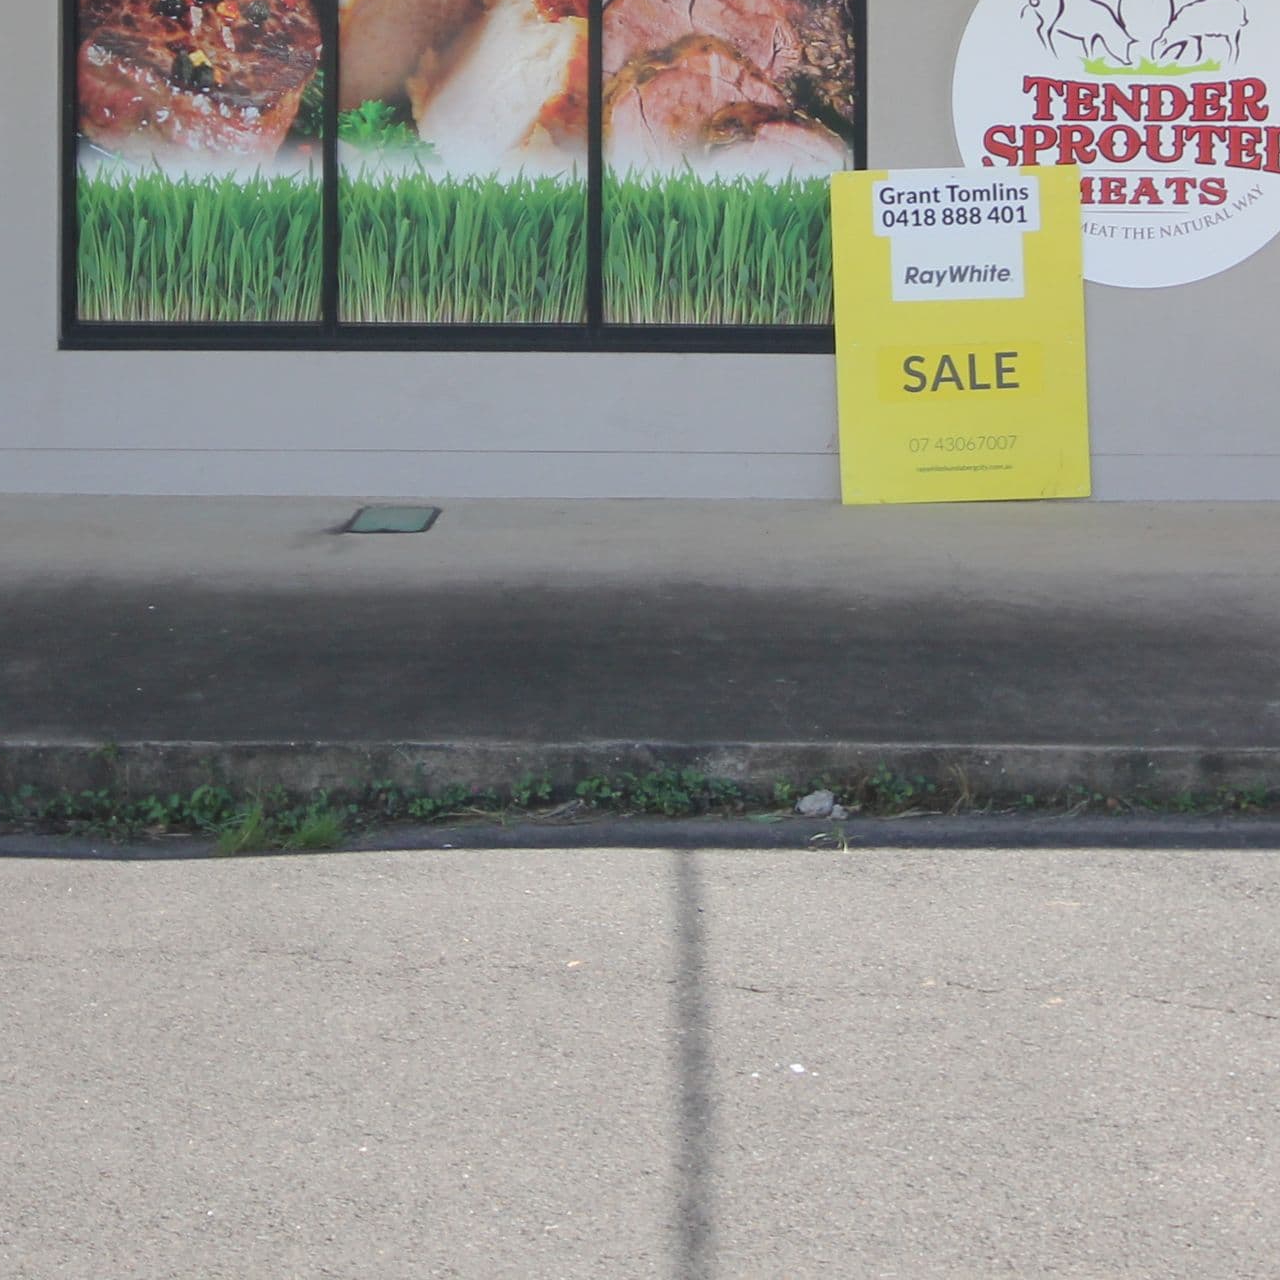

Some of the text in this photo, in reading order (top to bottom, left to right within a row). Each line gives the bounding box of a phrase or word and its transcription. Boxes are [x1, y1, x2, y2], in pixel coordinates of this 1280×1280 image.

[1023, 76, 1270, 122] TENDER
[879, 182, 1029, 205] Grant Tomlins
[882, 204, 1028, 228] 0418 888 401
[1122, 225, 1156, 240] THE
[1159, 206, 1235, 238] NATURAL
[1231, 183, 1265, 213] WAY
[902, 351, 1020, 393] SALE
[908, 437, 929, 453] 07
